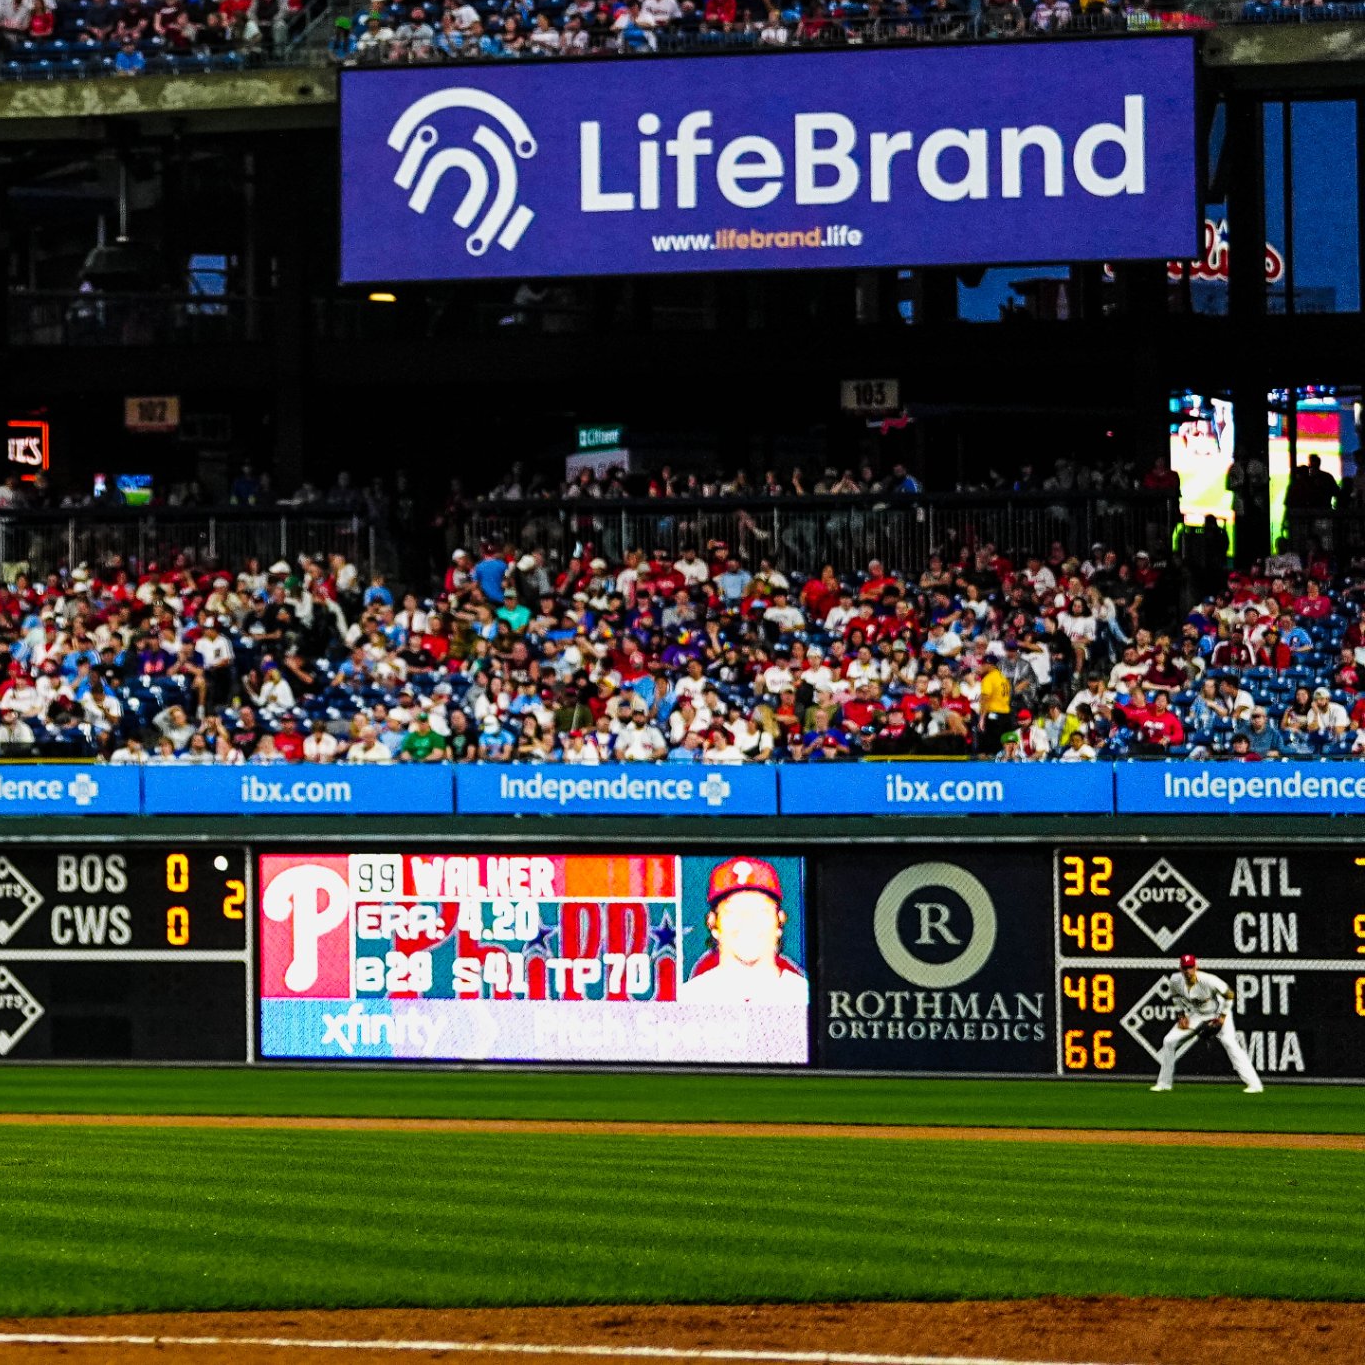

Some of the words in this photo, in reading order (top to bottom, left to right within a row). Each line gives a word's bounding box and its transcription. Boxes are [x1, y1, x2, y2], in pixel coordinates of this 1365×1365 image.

[580, 95, 1147, 214] LifeBrand
[652, 225, 863, 254] www.lifebrand.life
[241, 775, 351, 803] ibx.com
[500, 774, 692, 805] Independence
[886, 774, 1003, 802] ibx.com
[57, 854, 127, 893] BOS
[167, 854, 189, 893] 0
[411, 857, 555, 897] WALKER
[1063, 856, 1113, 896] 32
[1229, 857, 1302, 897] ATL
[223, 881, 245, 919] 2
[1139, 887, 1187, 903] OUTS
[51, 906, 132, 945] CWS
[167, 906, 189, 945] 0
[357, 905, 445, 940] ERA:
[457, 902, 539, 940] 4.20
[913, 903, 960, 945] R
[1062, 912, 1114, 952] 48
[1233, 912, 1299, 954] CIN
[827, 991, 1044, 1020] ROTHMAN
[1063, 974, 1115, 1013] 48
[1235, 975, 1296, 1015] PIT
[1141, 1005, 1179, 1021] OUT
[321, 1003, 449, 1055] xfinity
[827, 1021, 1045, 1041] ORTHOPAEDICS
[1064, 1030, 1116, 1070] 66
